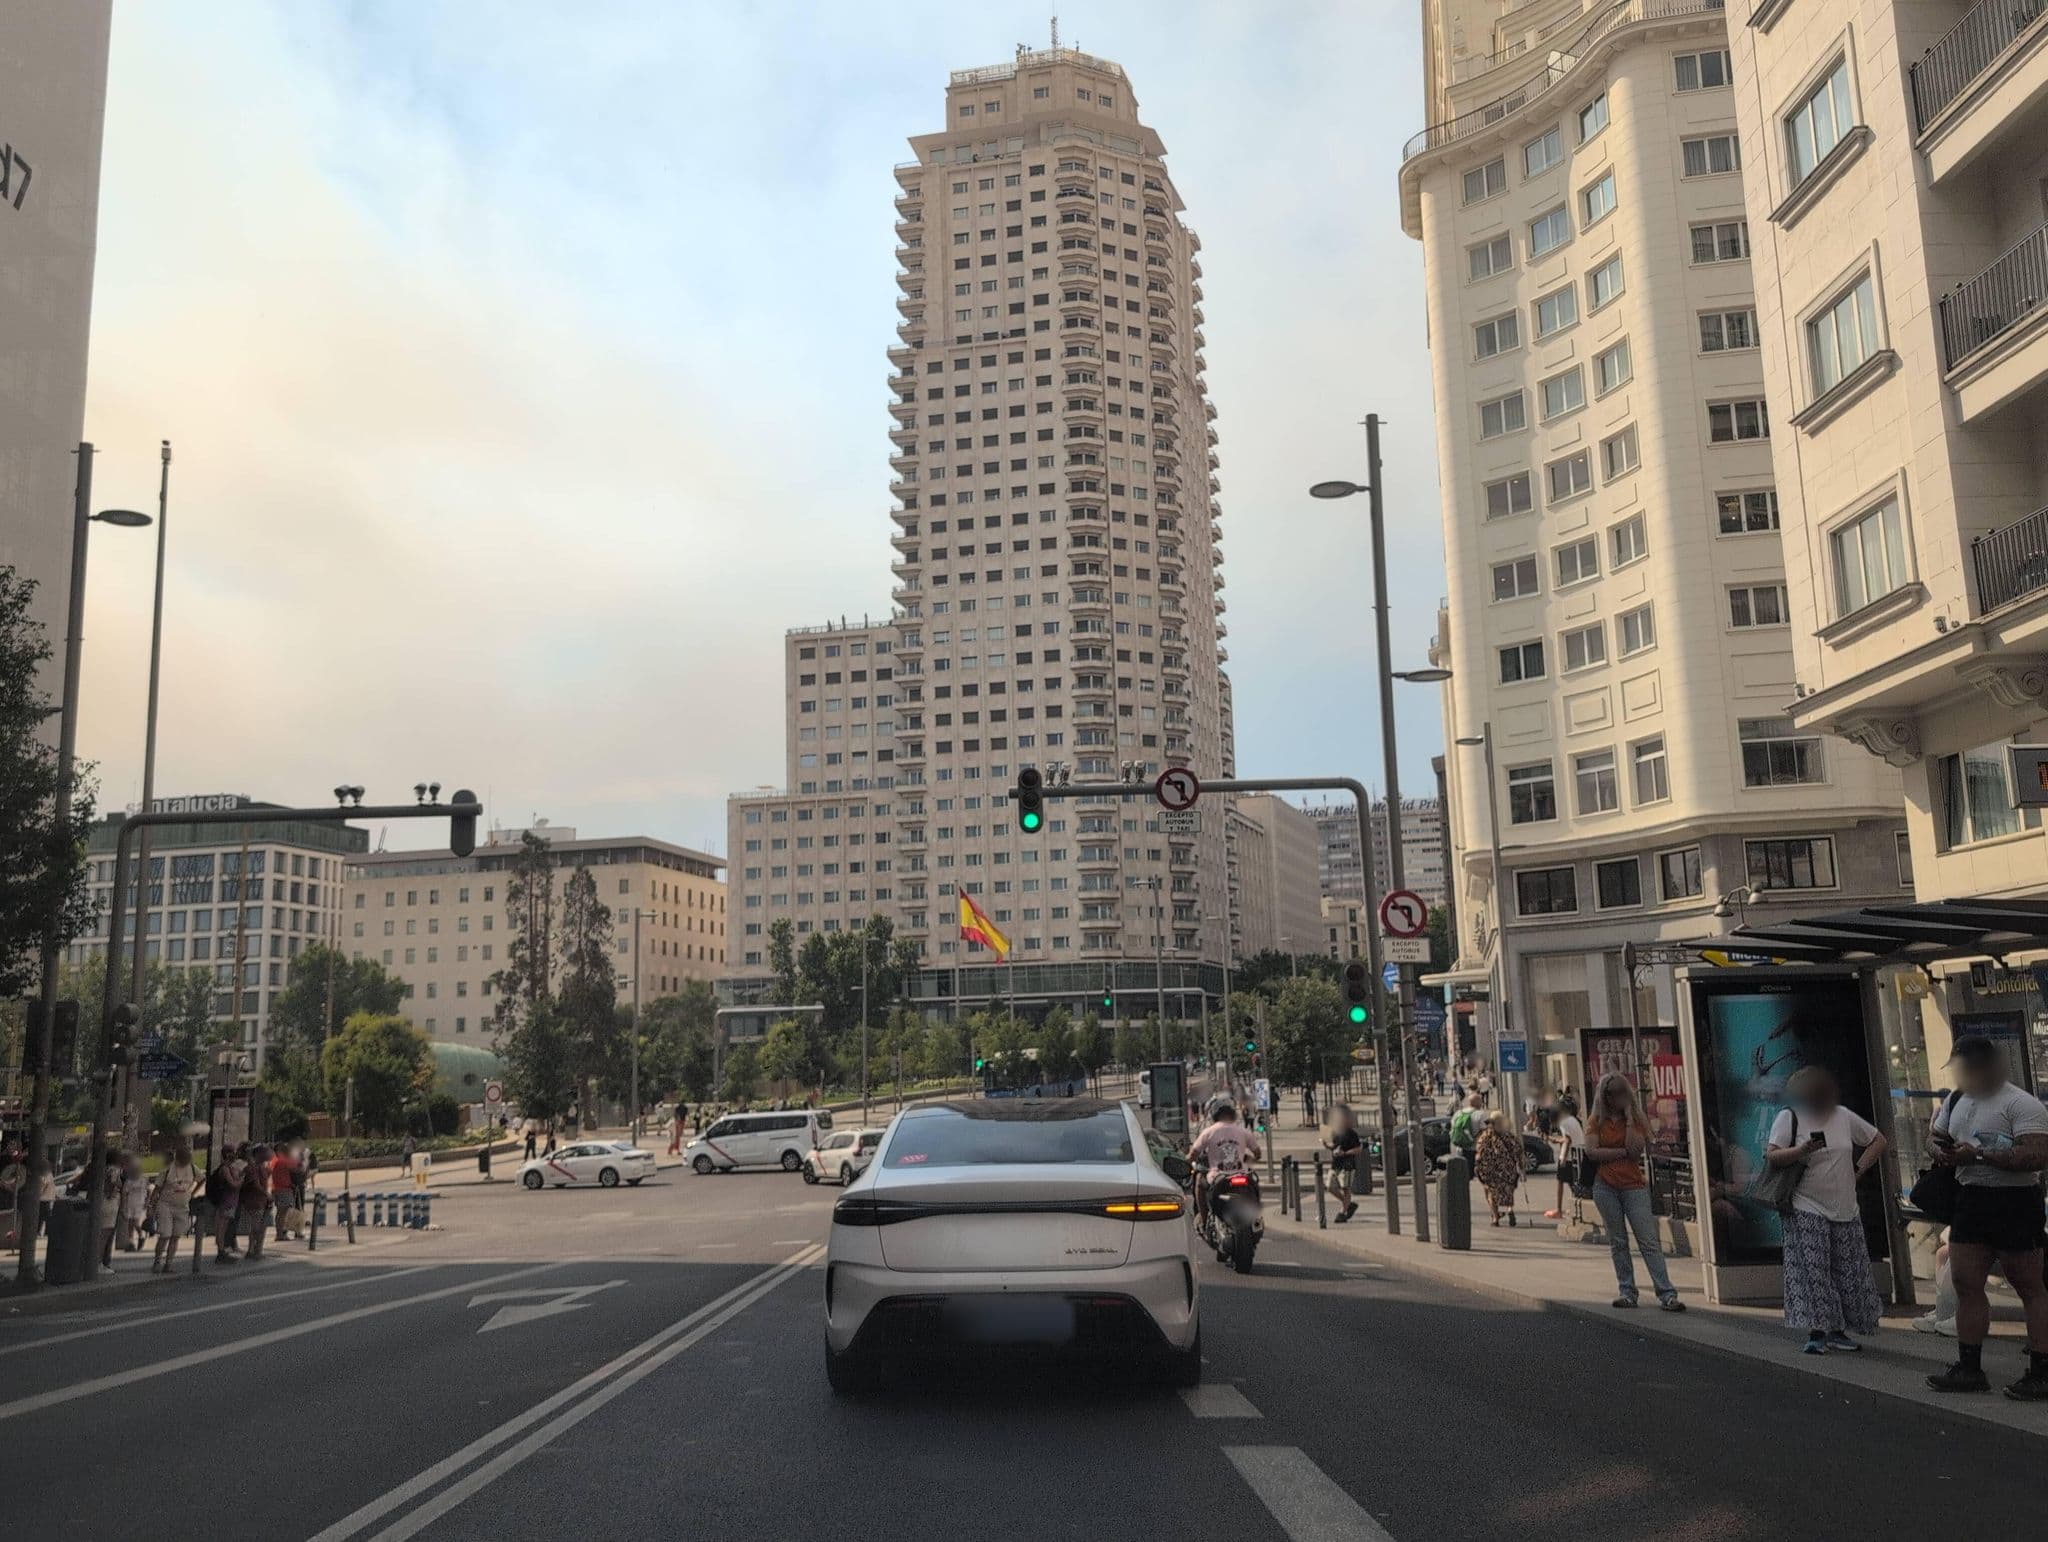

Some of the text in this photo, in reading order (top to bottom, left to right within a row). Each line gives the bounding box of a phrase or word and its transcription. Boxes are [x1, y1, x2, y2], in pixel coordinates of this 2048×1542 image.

[1333, 804, 1358, 816] Mel
[1371, 799, 1414, 814] Maid
[1419, 797, 1440, 810] Pri
